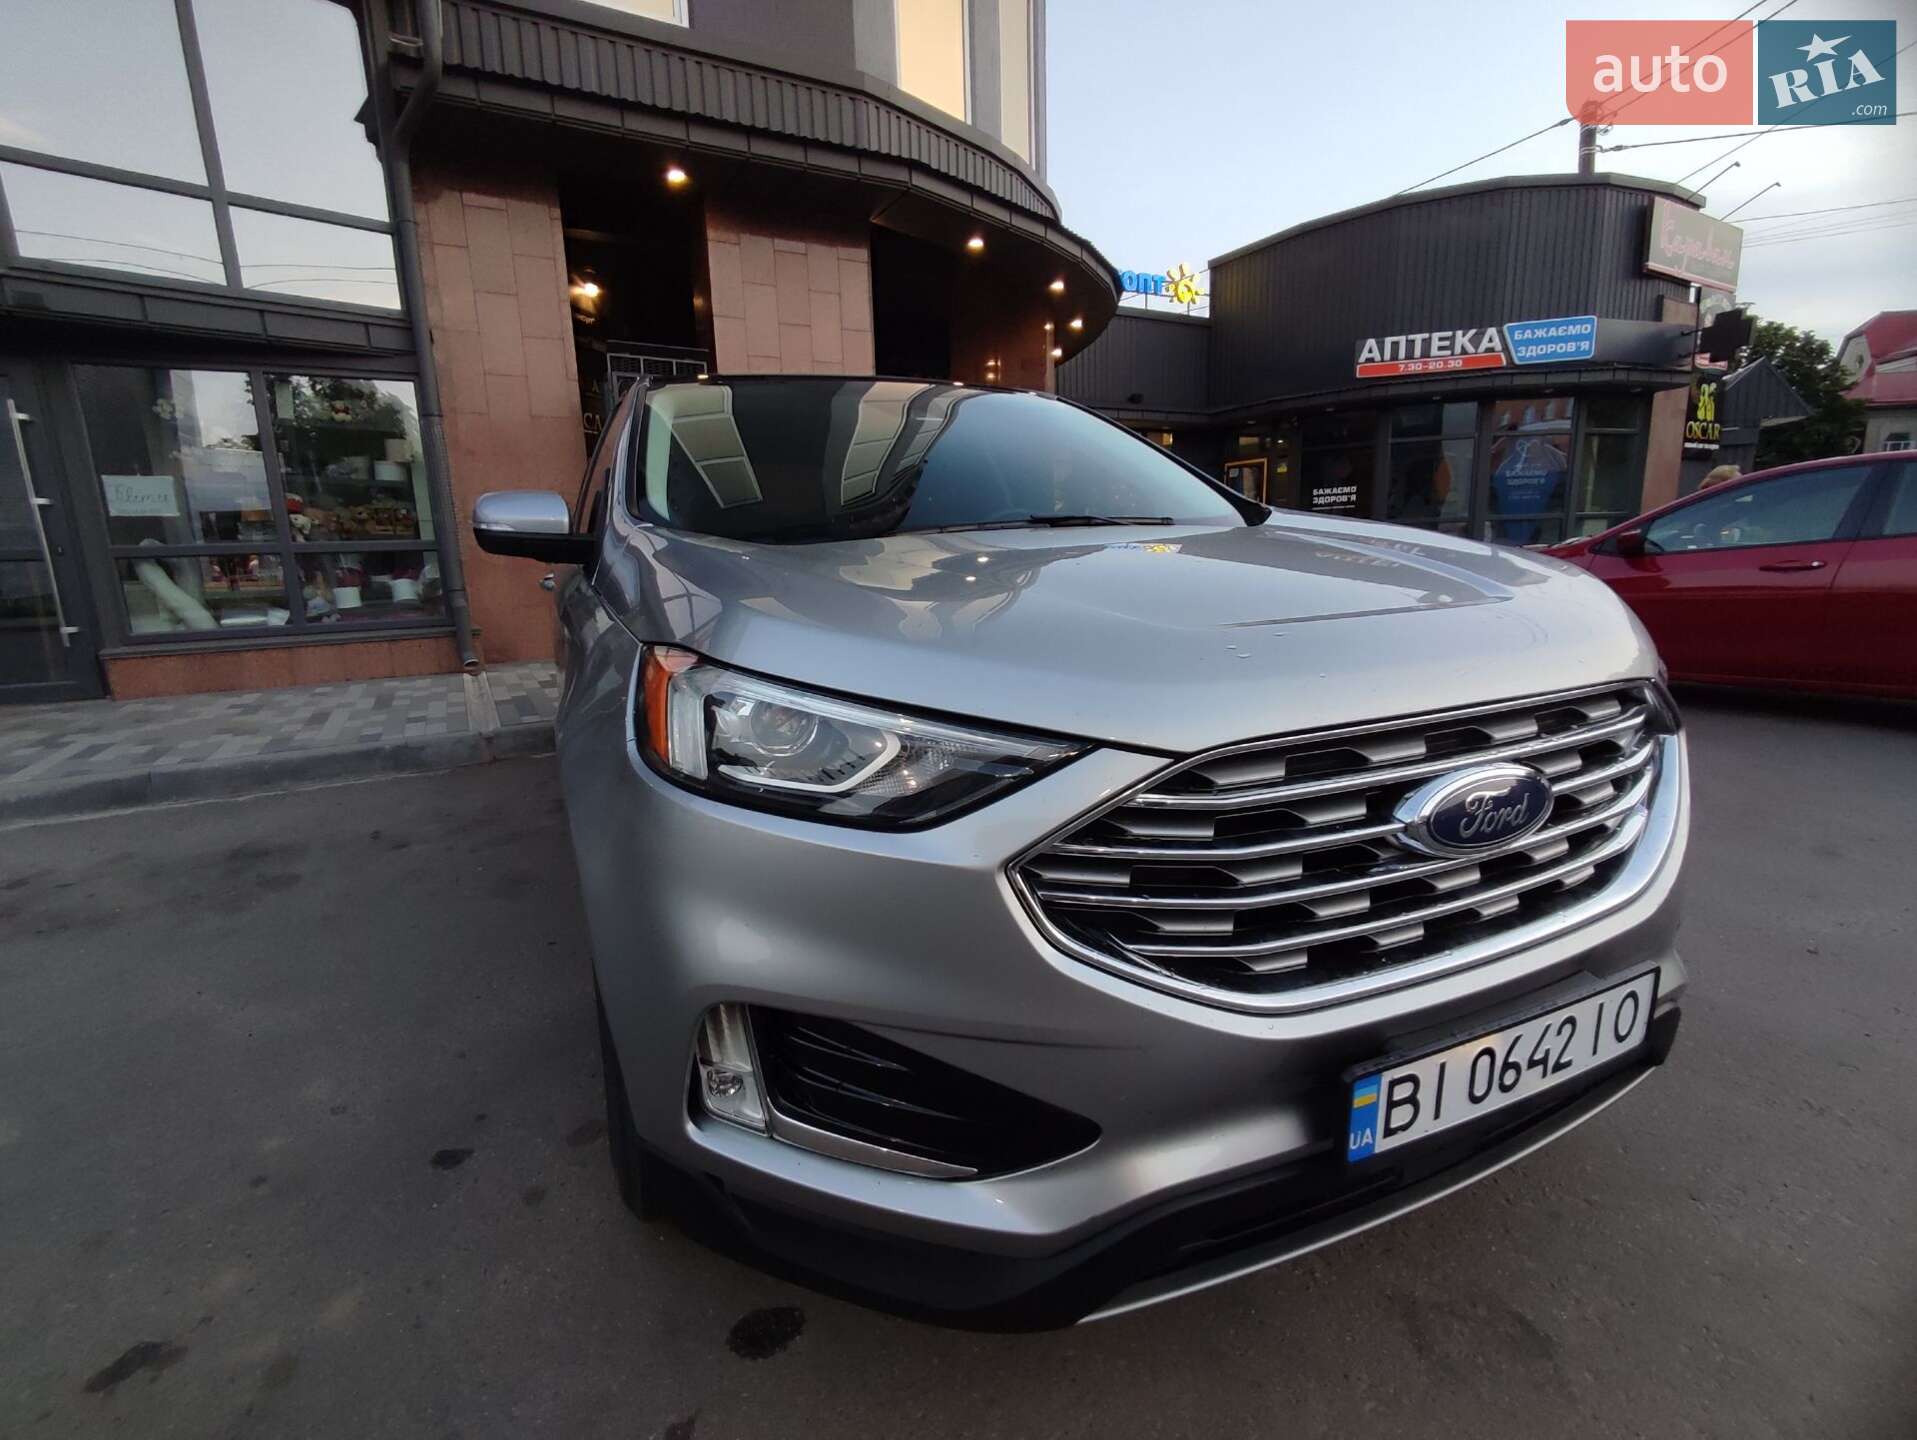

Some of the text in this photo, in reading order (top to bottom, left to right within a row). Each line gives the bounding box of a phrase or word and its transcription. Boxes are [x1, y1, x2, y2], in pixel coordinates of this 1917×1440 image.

[1513, 323, 1591, 341] БАЖАЄМО
[1357, 327, 1503, 363] АПТЕКА
[1516, 341, 1590, 358] ЗДОРОВ'Я
[1686, 421, 1721, 440] OSCAR
[1458, 786, 1531, 840] Ford
[1382, 989, 1640, 1139] BI 0642 IO
[1349, 1127, 1374, 1150] UA
